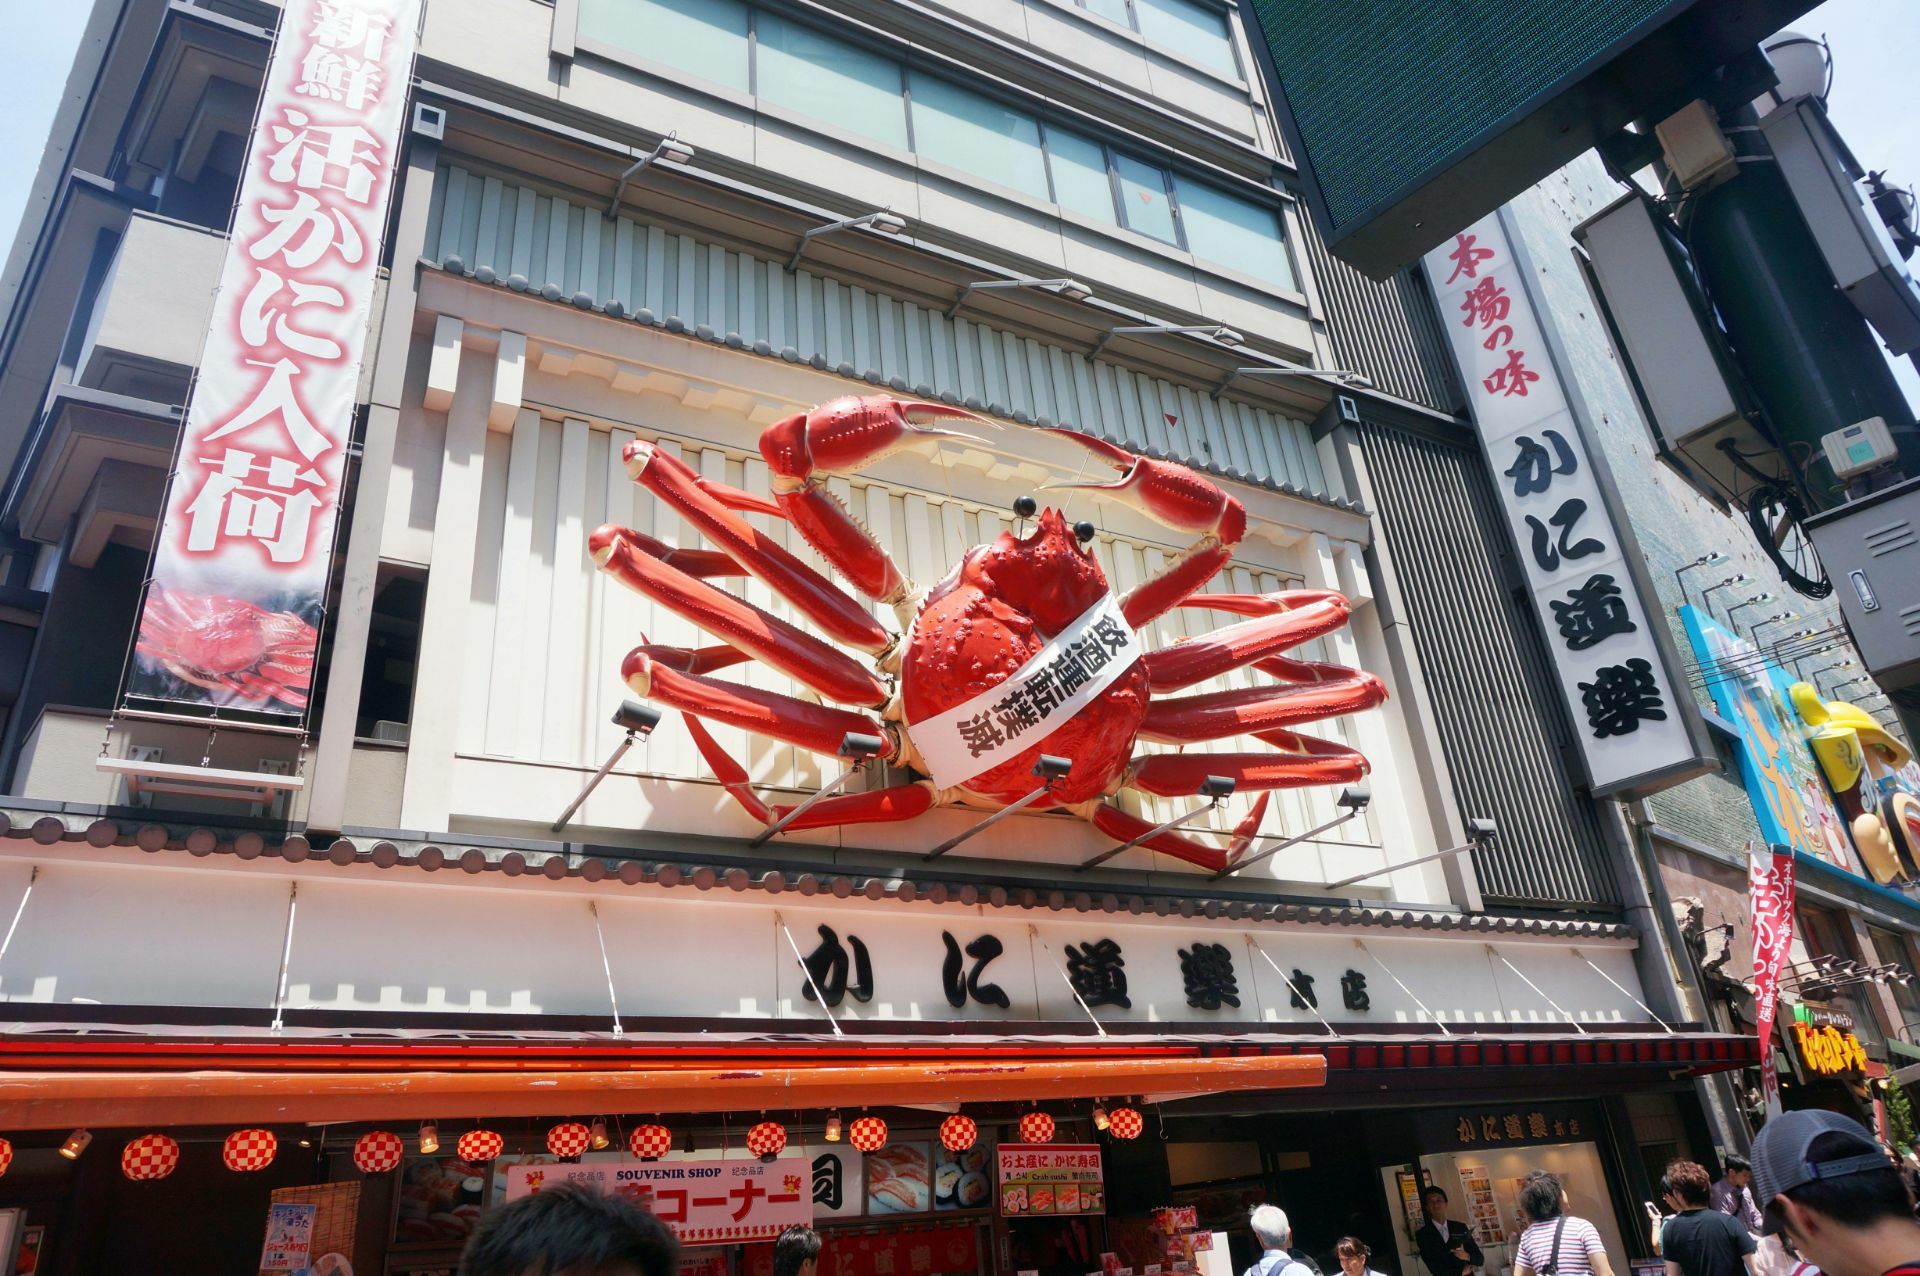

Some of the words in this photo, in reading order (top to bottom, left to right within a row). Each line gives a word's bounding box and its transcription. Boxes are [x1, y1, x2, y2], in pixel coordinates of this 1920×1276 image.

[1445, 234, 1540, 397] 本場の味
[956, 614, 1128, 758] 飲酒運転撲滅
[616, 1168, 685, 1180] SOUVENIR
[688, 1168, 722, 1178] SHOP
